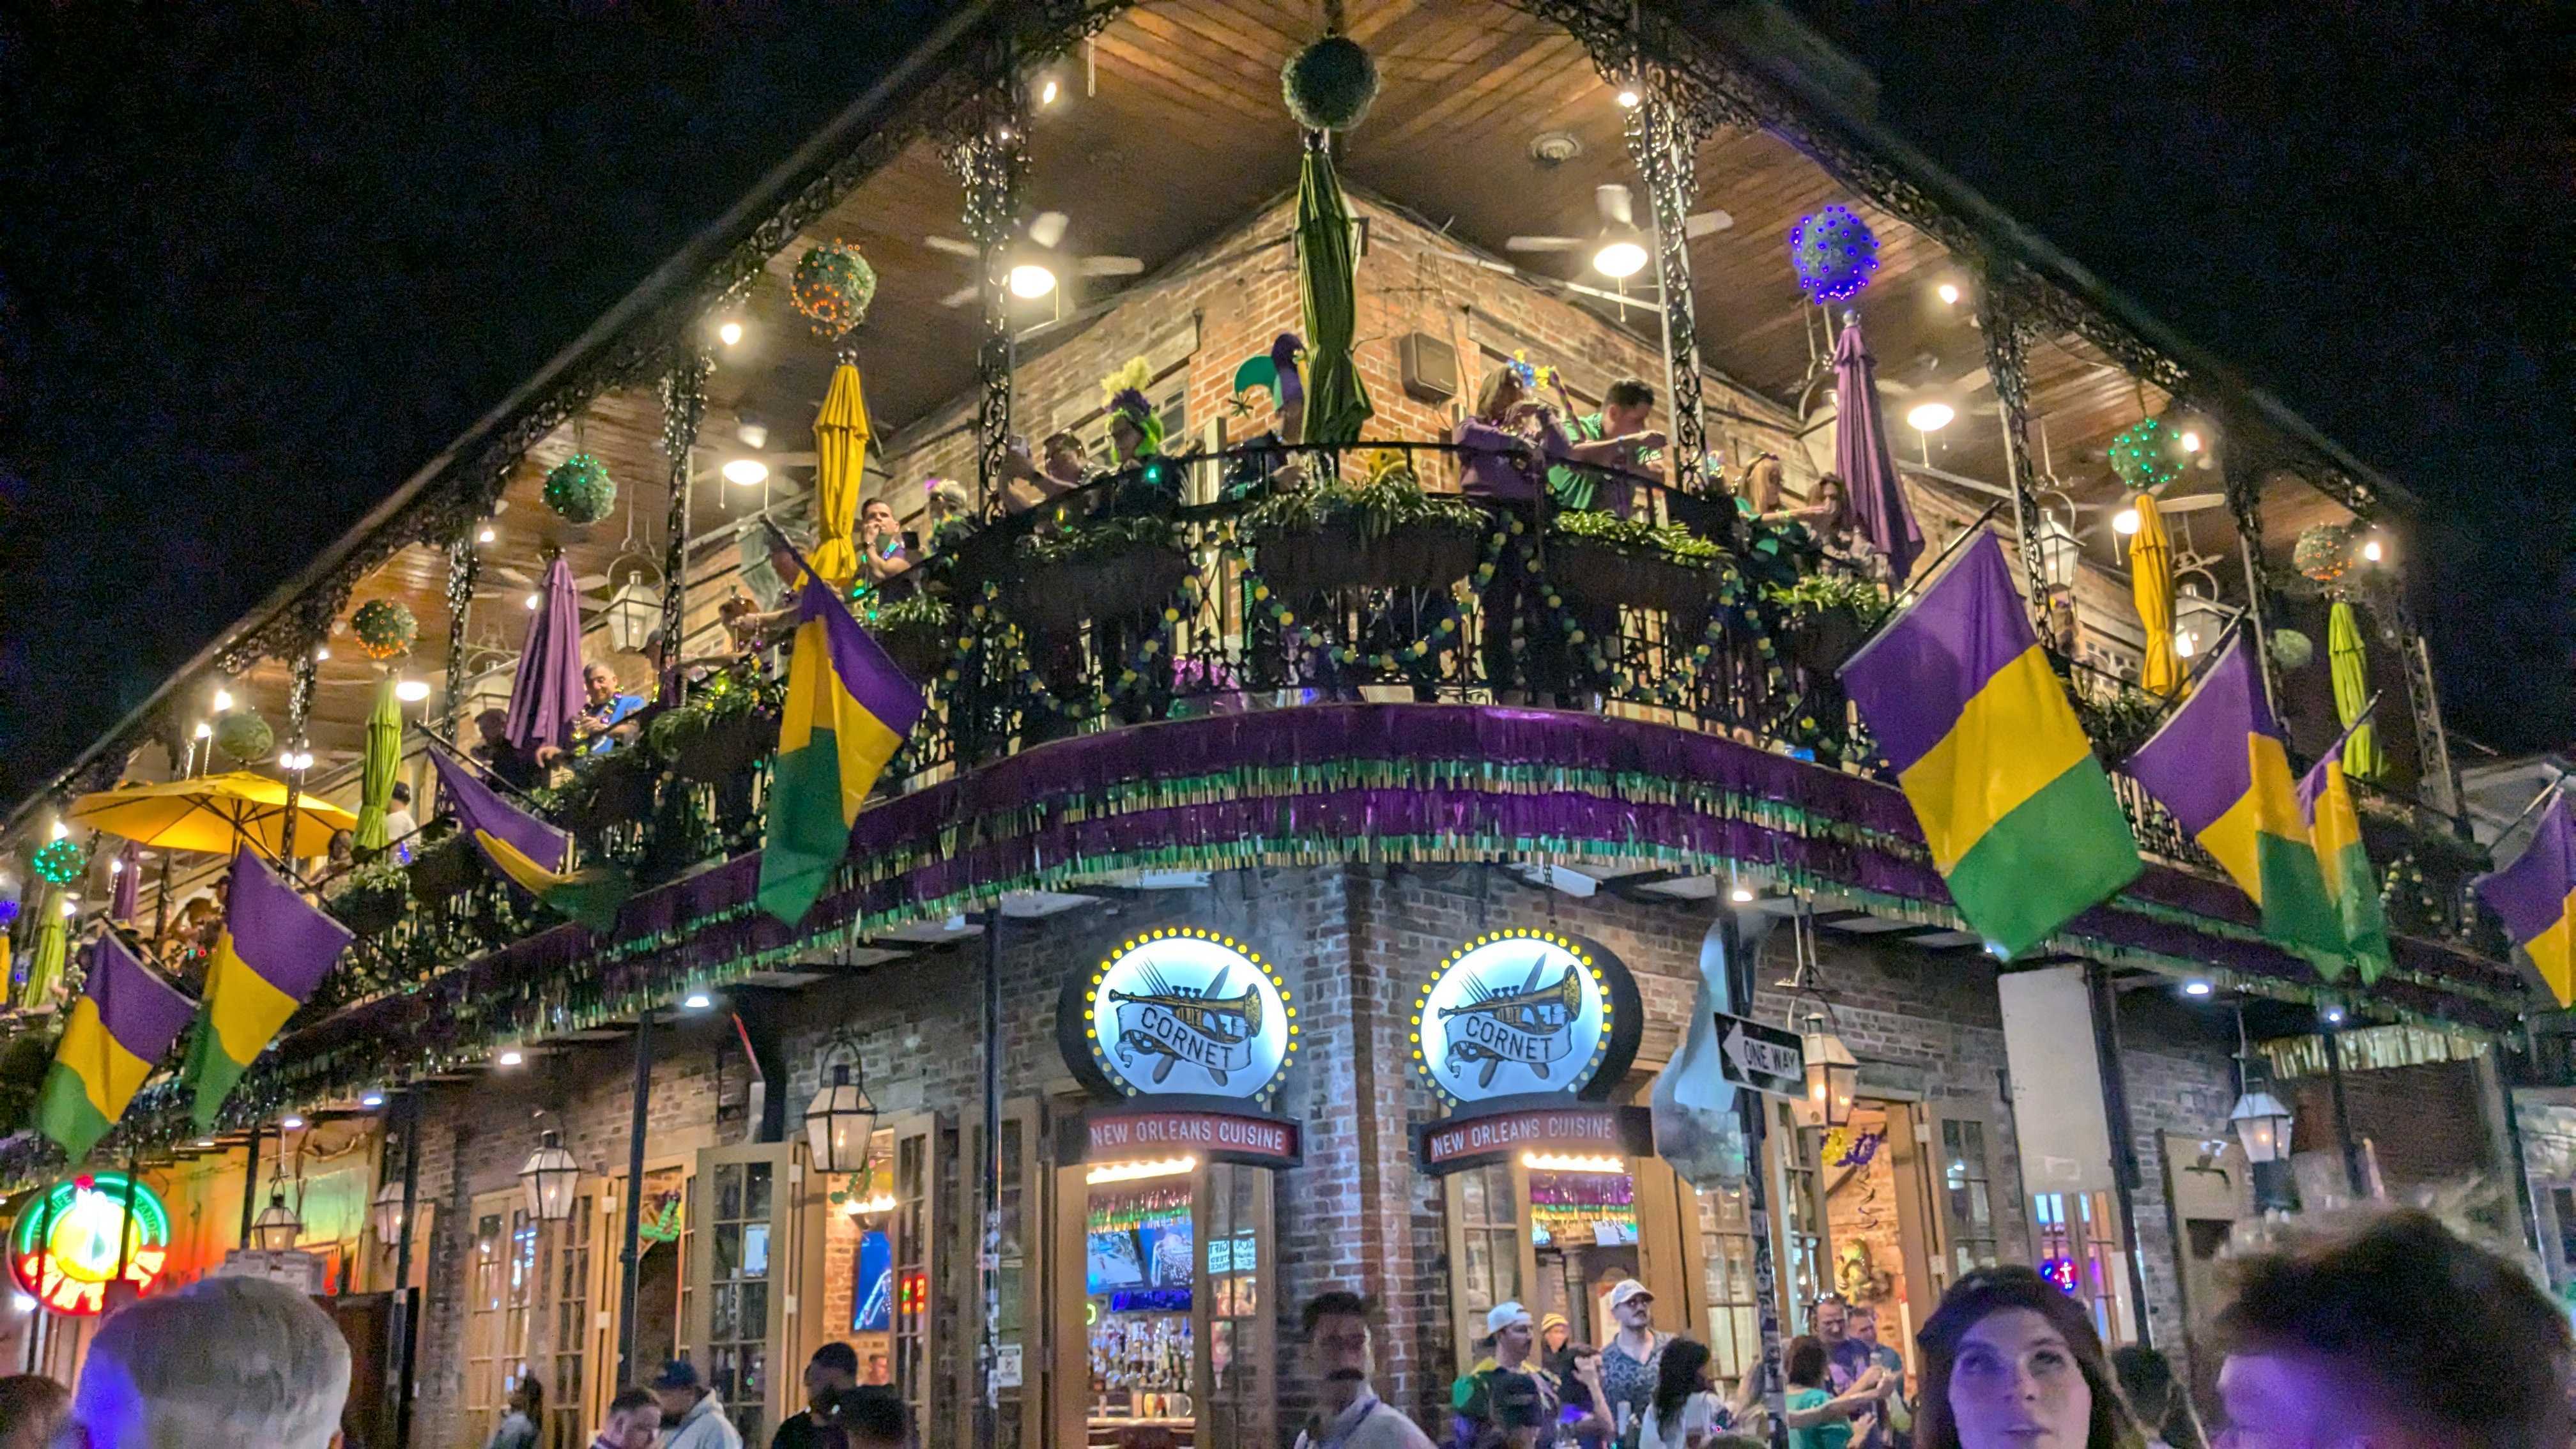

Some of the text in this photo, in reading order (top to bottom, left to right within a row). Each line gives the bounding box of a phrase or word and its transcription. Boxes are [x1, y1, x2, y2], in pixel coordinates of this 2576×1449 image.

[1141, 1007, 1233, 1070] CORNET
[1466, 1015, 1553, 1061] CORNET
[1744, 1039, 1797, 1075] ONE WAY
[1089, 1119, 1284, 1151] NEW ORLEANS CUISINE
[1432, 1117, 1613, 1157] NEW ORLEANS CUISINE
[134, 1197, 159, 1236] RANDE
